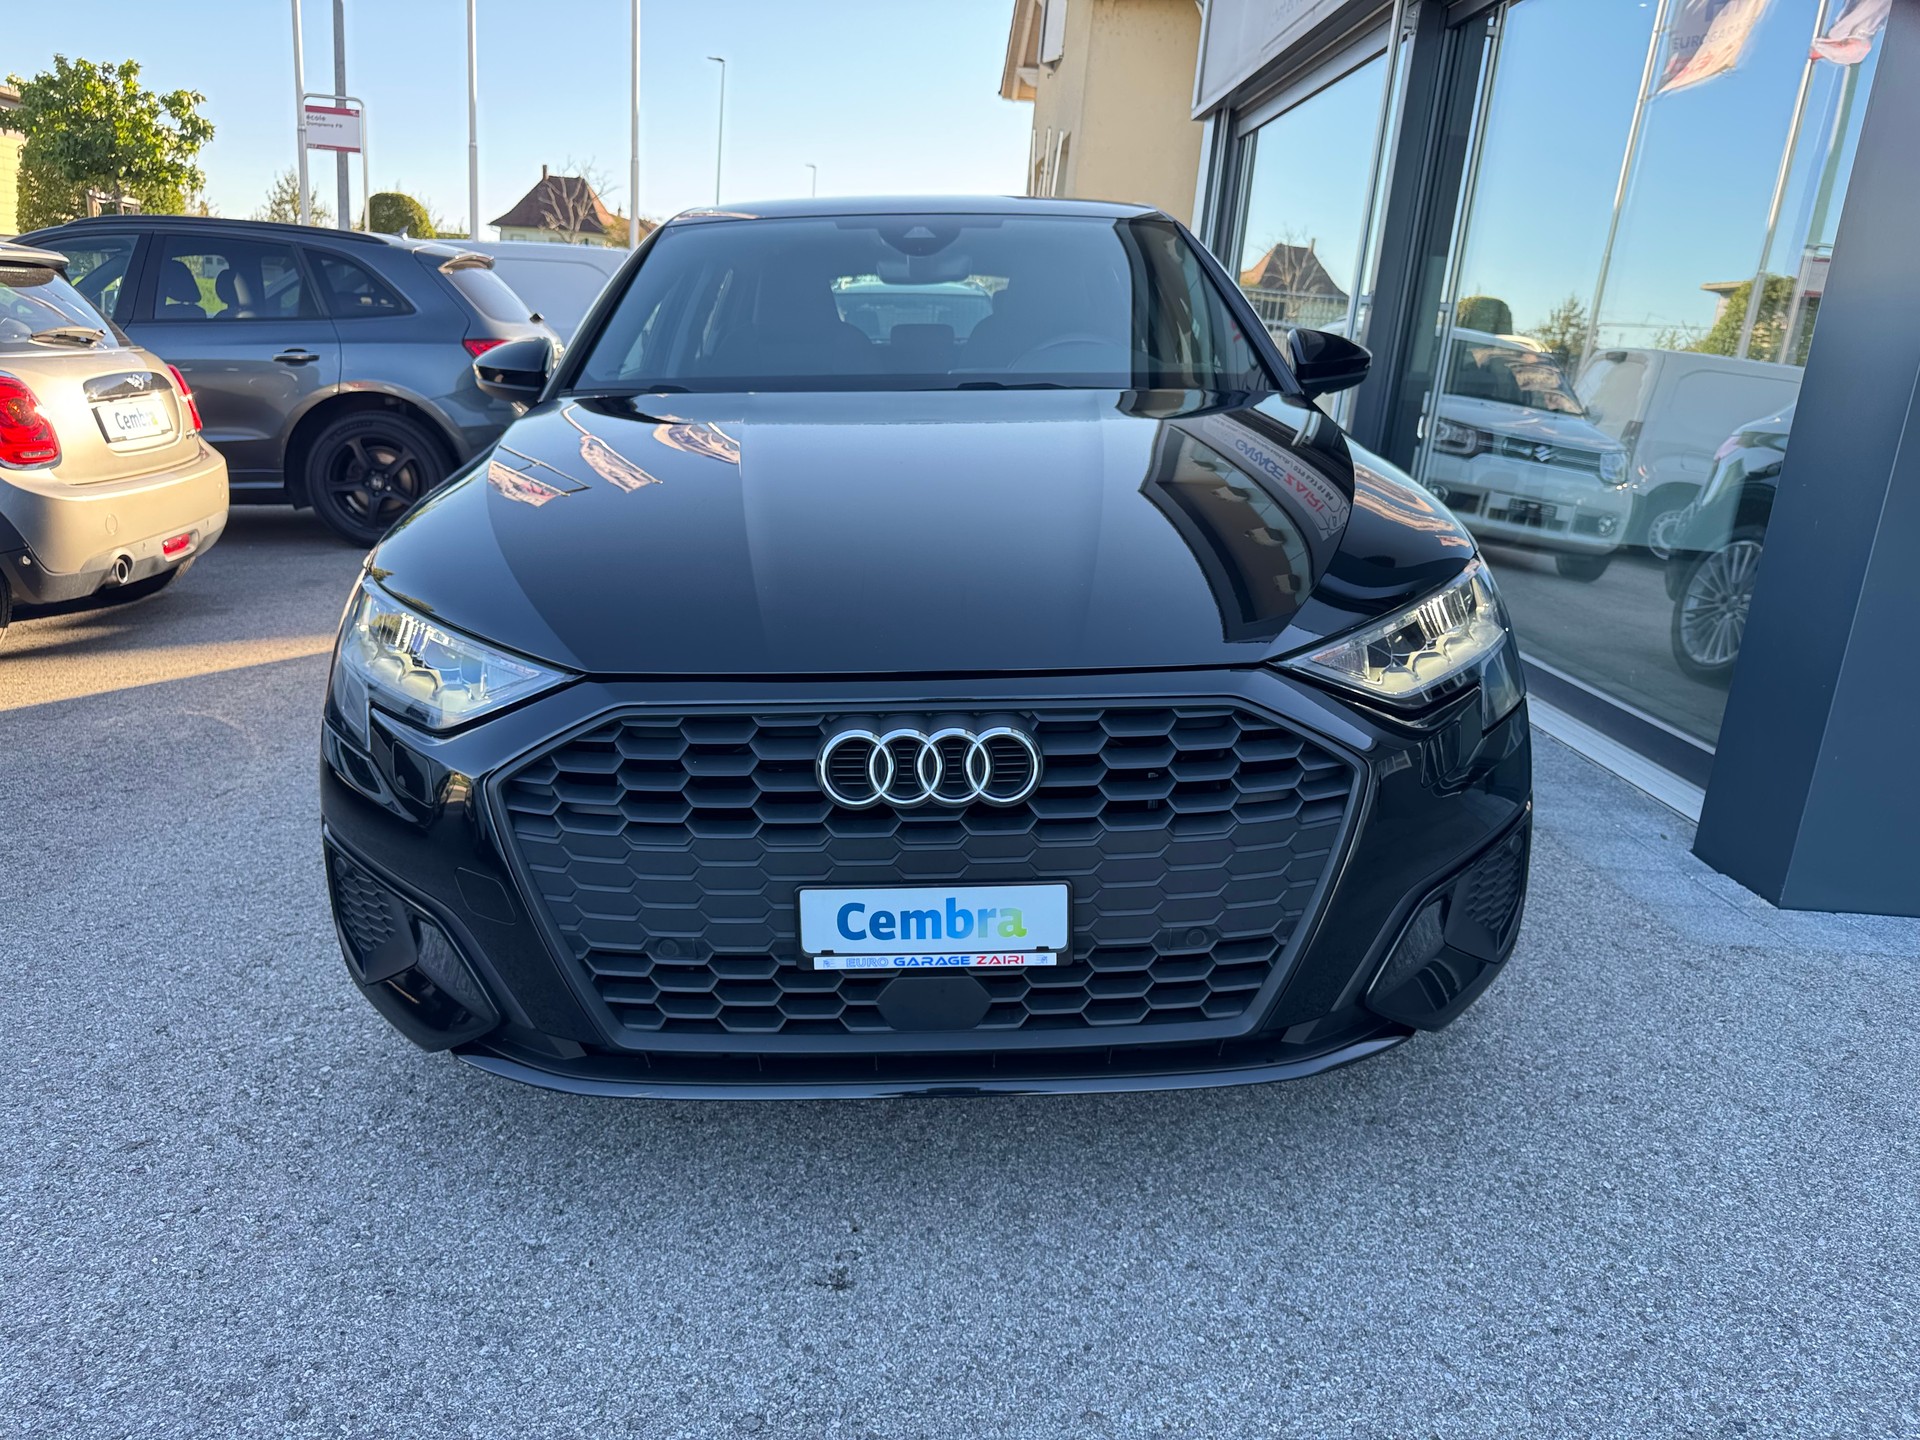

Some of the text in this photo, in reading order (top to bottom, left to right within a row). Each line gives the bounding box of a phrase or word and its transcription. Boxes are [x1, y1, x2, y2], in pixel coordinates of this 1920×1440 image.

[836, 897, 1028, 941] Cembra
[846, 955, 1025, 968] EURO GARAGE ZAIRI
